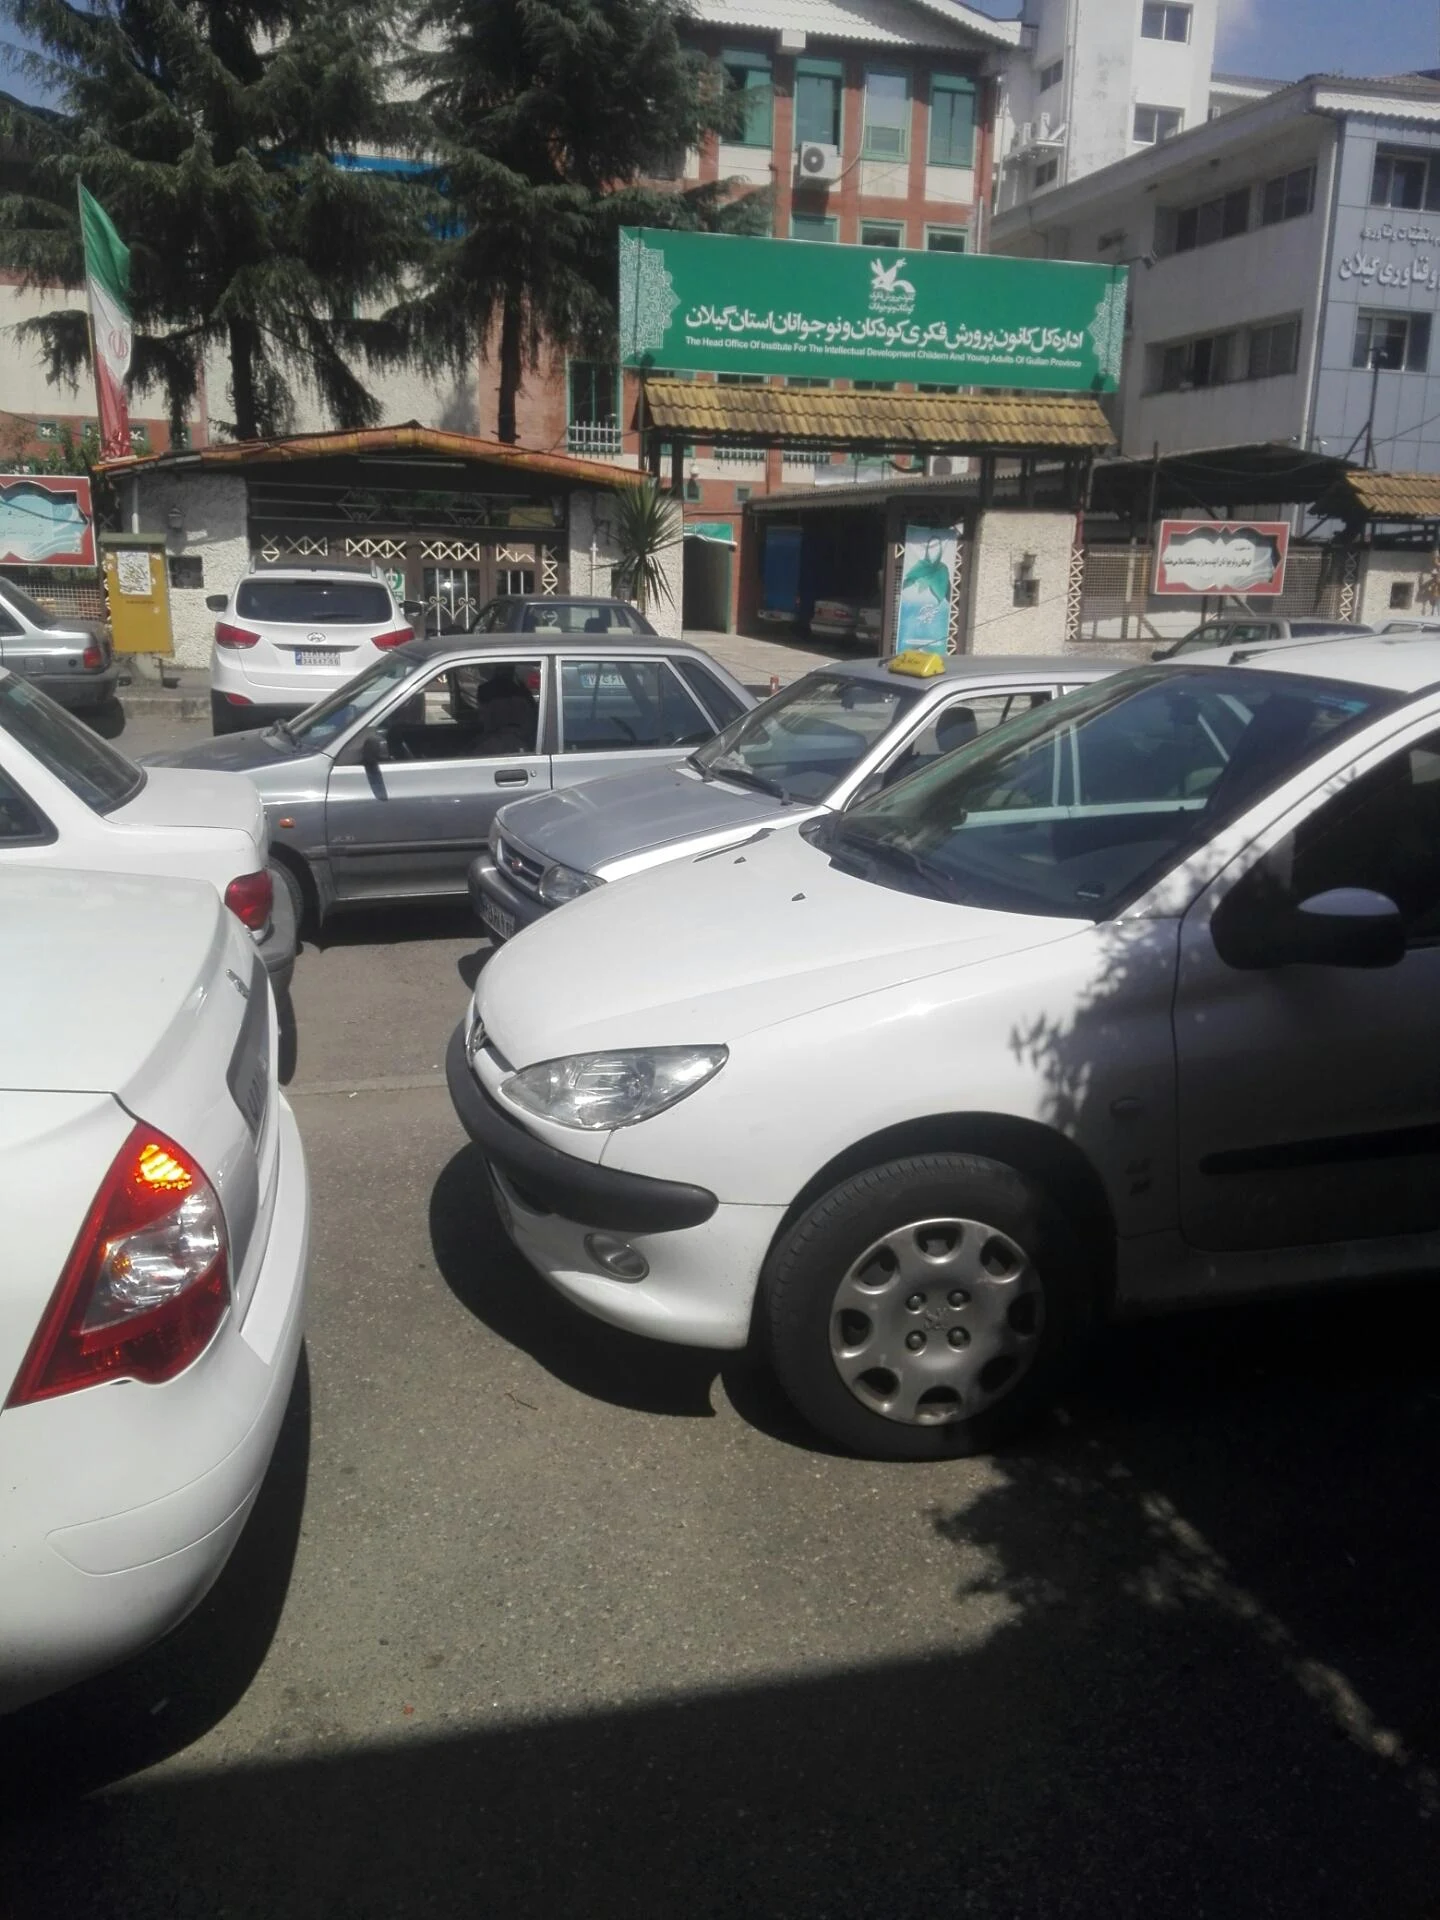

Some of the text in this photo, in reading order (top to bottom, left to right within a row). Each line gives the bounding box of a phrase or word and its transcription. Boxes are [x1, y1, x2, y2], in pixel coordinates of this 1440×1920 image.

[685, 304, 1083, 353] اداره کل کانون پرورش فکری کودکان و نوجوانان استان گیلان
[685, 335, 700, 346] The
[702, 336, 724, 347] Head
[724, 338, 748, 349] Office
[750, 339, 760, 349] Of
[761, 341, 792, 352] Institute
[793, 342, 807, 352] For
[808, 343, 823, 353] The
[824, 344, 865, 356] Intellectual
[866, 346, 916, 361] Development
[949, 351, 965, 362] And
[966, 352, 989, 365] Young
[1050, 357, 1082, 368] Province
